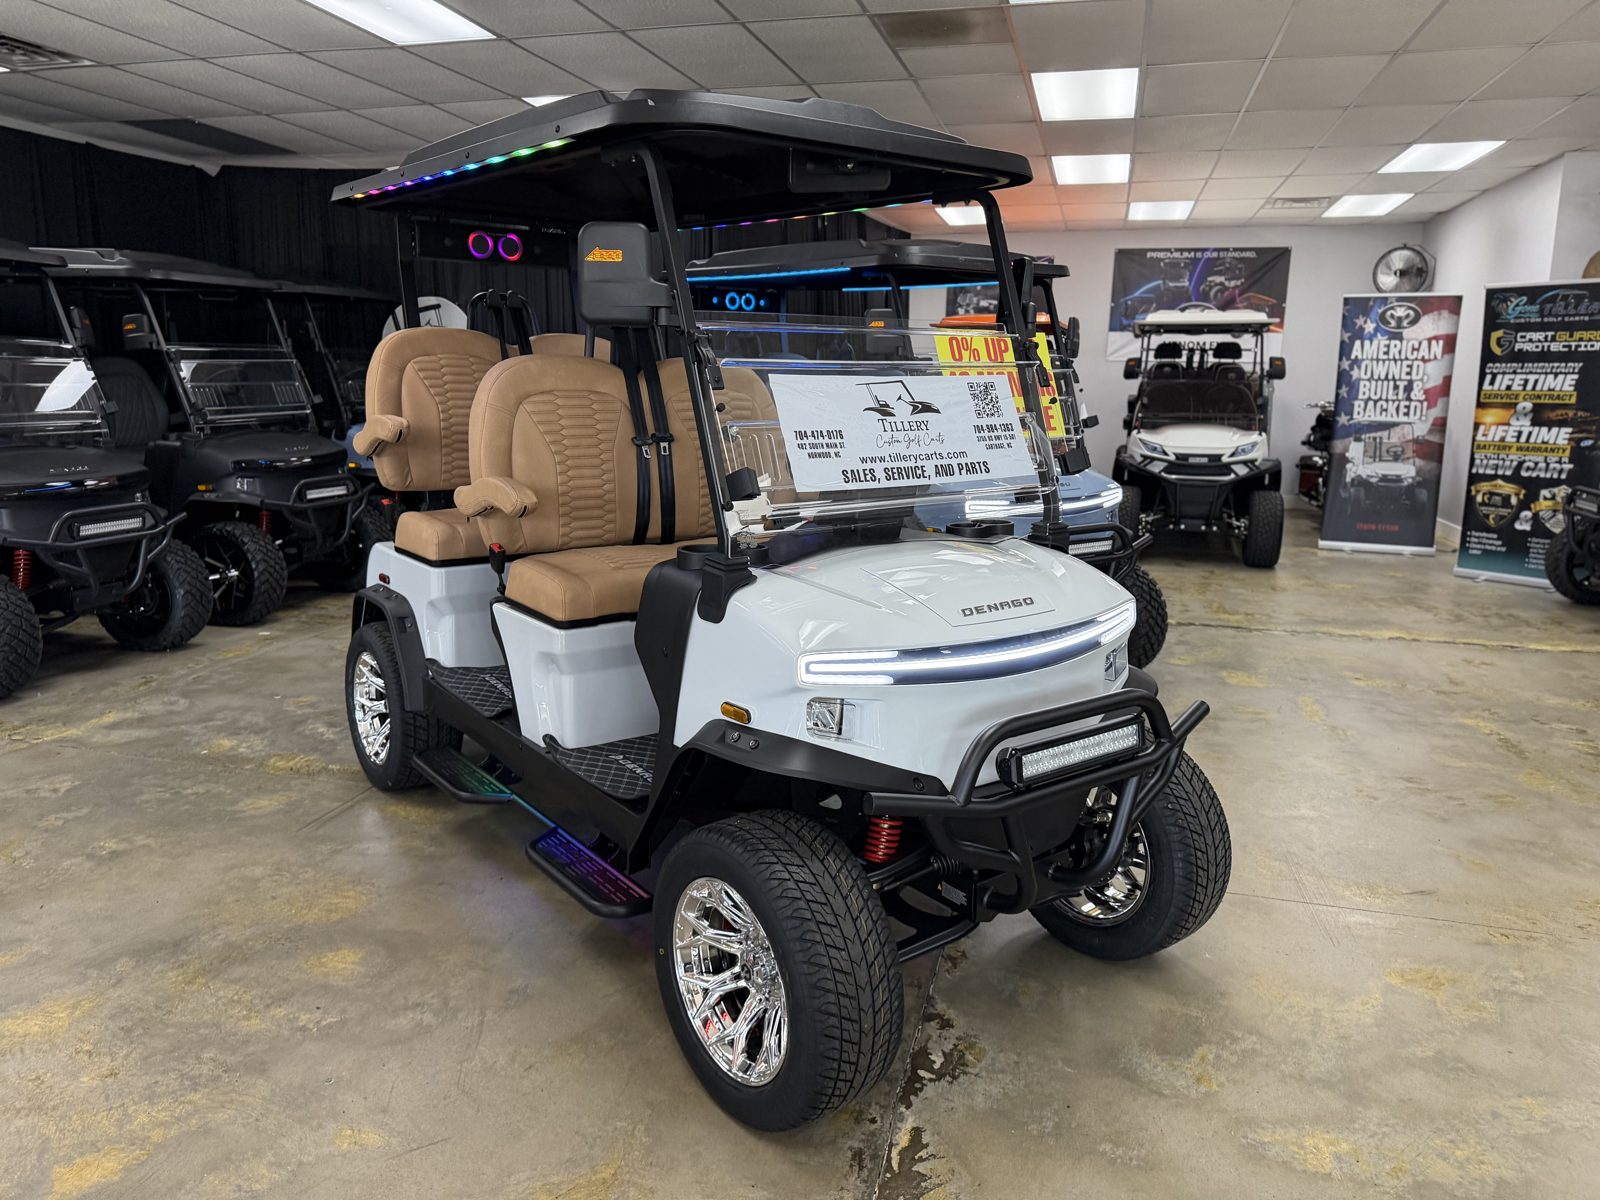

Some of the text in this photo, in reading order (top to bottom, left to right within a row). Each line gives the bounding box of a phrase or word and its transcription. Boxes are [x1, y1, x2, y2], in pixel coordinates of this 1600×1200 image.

[1146, 251, 1195, 259] PREMIUM
[1219, 250, 1258, 258] STANDARD.
[1517, 330, 1600, 342] CART GUAR
[948, 336, 1010, 363] 0% UP
[1350, 339, 1444, 360] AMERICAN
[1360, 360, 1428, 382] OWNED,
[1485, 362, 1583, 373] COMPLIMENTARY
[1358, 380, 1426, 400] BUILT &
[1482, 373, 1579, 391] LIFETIME
[1482, 392, 1575, 401] SERVICE CONTRACT
[1352, 400, 1428, 421] BACKED!
[878, 418, 930, 433] TILLERY
[793, 429, 844, 441] 704-474-0176
[876, 432, 945, 449] Custom Golf Carts
[1475, 424, 1573, 445] LIFETIME
[808, 442, 825, 450] SOUTH
[1475, 443, 1569, 455] BATTERY WARRANTY
[859, 449, 968, 465] www.tillerycarts.com
[841, 460, 991, 484] SALES, SERVICE, AND PARTS
[1471, 459, 1575, 480] NEW CART
[960, 597, 1035, 617] DENAGO
